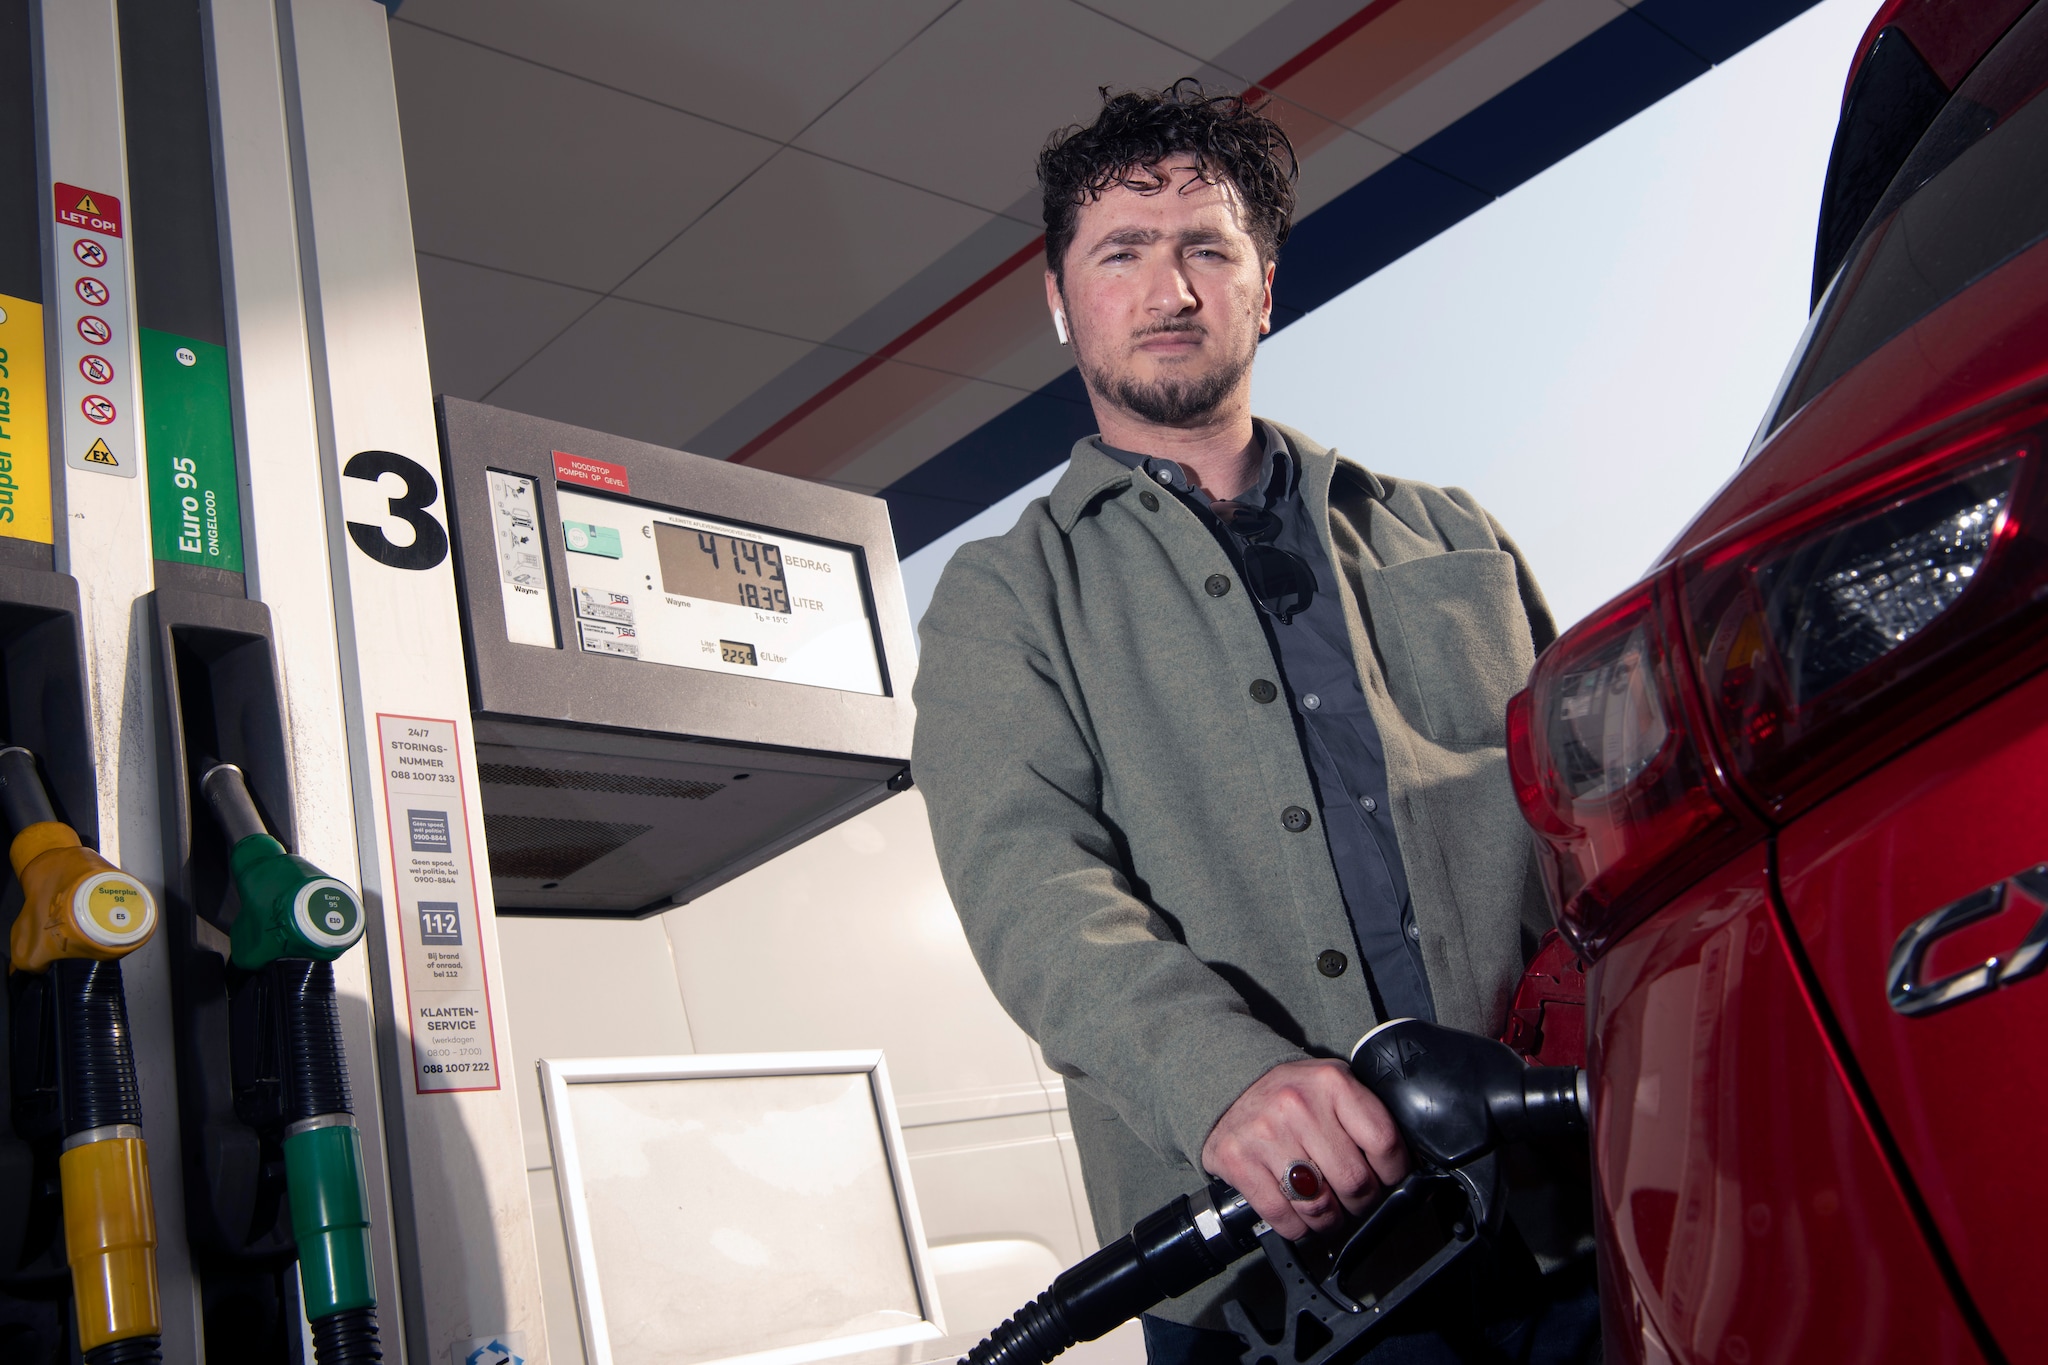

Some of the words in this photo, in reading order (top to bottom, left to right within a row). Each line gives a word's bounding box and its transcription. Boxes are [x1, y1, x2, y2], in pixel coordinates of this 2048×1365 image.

[61, 210, 88, 225] LET
[91, 218, 116, 233] OP!
[179, 352, 193, 361] E10
[93, 450, 109, 462] EX
[173, 457, 198, 489] 95
[571, 461, 610, 475] NOODSTOP
[558, 467, 588, 479] POMPEN
[591, 473, 601, 482] OP
[604, 477, 625, 487] GEVEL
[343, 450, 448, 571] 3
[179, 496, 202, 553] Euro
[205, 490, 220, 556] ONGELOOD
[642, 525, 651, 539] €
[784, 555, 831, 573] BEDRAG
[513, 584, 539, 596] Wayne
[608, 593, 629, 605] TSG
[665, 596, 691, 608] Wayne
[792, 596, 824, 612] LITER
[616, 626, 635, 638] TSG
[760, 652, 788, 663] €/Liter
[408, 728, 429, 738] 24/7
[391, 741, 448, 753] STORINGS-
[399, 756, 444, 768] NUMMER
[391, 770, 410, 780] 088
[413, 772, 437, 782] 1007
[438, 774, 455, 783] 333
[423, 868, 447, 876] politie,
[414, 876, 456, 884] 0900-8844
[99, 887, 138, 896] Superplus
[428, 952, 437, 961] Bij
[427, 961, 435, 969] of
[420, 1007, 479, 1018] KLANTEN-
[427, 1020, 476, 1031] SERVICE
[432, 1036, 475, 1045] (werkdagen
[423, 1064, 443, 1074] 088
[445, 1063, 470, 1073] 1007
[472, 1062, 490, 1072] 222
